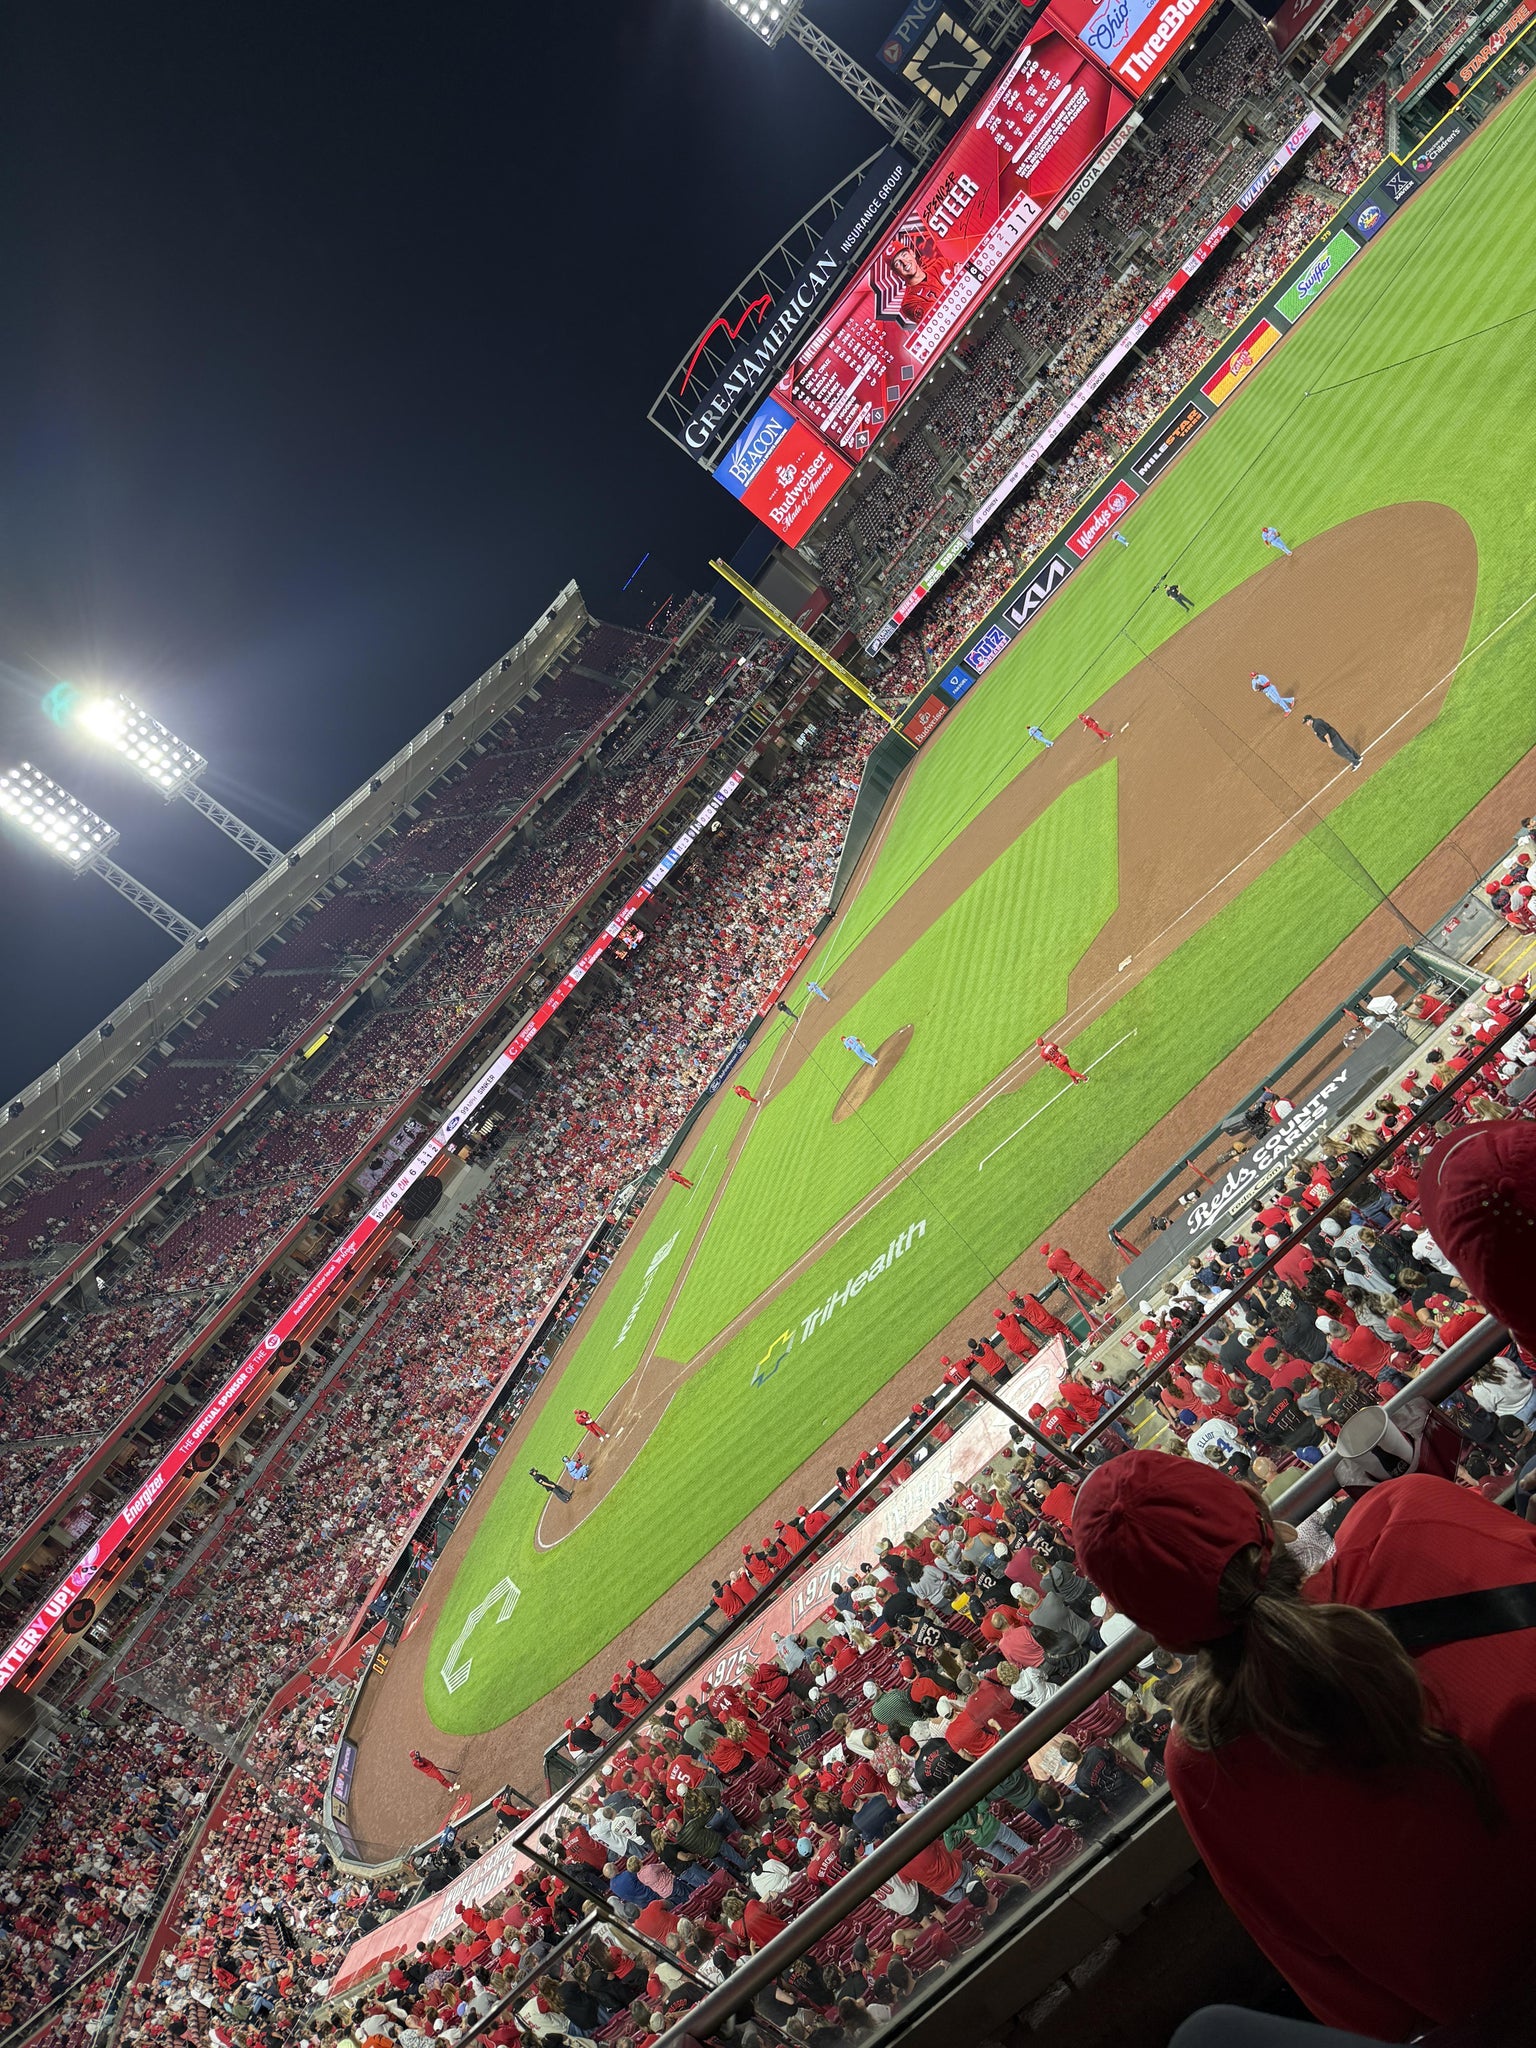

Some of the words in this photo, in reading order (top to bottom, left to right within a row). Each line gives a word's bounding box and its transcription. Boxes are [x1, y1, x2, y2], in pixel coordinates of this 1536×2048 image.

[893, 0, 937, 44] PNC
[1088, 0, 1130, 50] Ohio
[1117, 0, 1201, 85] ThreeBo
[1456, 43, 1494, 82] STAR
[1497, 3, 1532, 39] FIRE
[1423, 73, 1439, 90] SAFETY
[1439, 53, 1457, 72] SERVICE
[1455, 44, 1466, 55] TEXT
[987, 116, 1002, 134] .273
[1003, 89, 1021, 110] .342
[1021, 60, 1041, 82] .449
[1015, 162, 1026, 175] HAS
[1023, 148, 1036, 164] TWO
[1033, 127, 1053, 151] CAREER
[1050, 109, 1066, 129] GAME
[1063, 85, 1085, 112] ENDING
[1031, 134, 1054, 162] INCLUDING
[1051, 121, 1064, 136] ONE
[1062, 90, 1087, 123] WALKOFF
[1283, 122, 1312, 156] ROSE
[1427, 124, 1462, 161] Children's
[1024, 159, 1041, 179] HOMER
[1066, 166, 1101, 207] TOYOTA
[1096, 122, 1135, 168] TUNDRA
[839, 197, 882, 253] INSURANCE
[877, 162, 910, 202] GROUP
[919, 170, 960, 221] SPENCER
[926, 173, 981, 237] STEER
[1393, 179, 1415, 201] XAVIER
[1006, 223, 1019, 235] 3
[1022, 202, 1036, 214] 2
[1203, 225, 1223, 246] MYERS
[1319, 229, 1332, 243] 379
[1298, 255, 1331, 299] Swiffer
[797, 325, 833, 366] CINCINNATI
[817, 357, 831, 374] CRUZ
[1229, 347, 1250, 377] Kahn's
[799, 367, 815, 385] DUNN
[810, 371, 830, 395] BLEDAY
[815, 371, 839, 400] STEWART
[1089, 371, 1107, 390] SINKER
[1178, 412, 1203, 437] TIRES
[727, 414, 785, 484] BEACON
[767, 448, 828, 524] Budweiser
[801, 459, 835, 500] America
[778, 502, 803, 532] Made
[797, 494, 810, 507] of
[1077, 508, 1113, 550] Wendy's
[938, 539, 964, 567] $39,105
[914, 704, 947, 743] Budweiser
[476, 1073, 496, 1095] SINKER
[1187, 1166, 1258, 1238] Reds
[1250, 1064, 1351, 1167] COUNTRY
[1256, 1100, 1329, 1174] CARES
[396, 1176, 410, 1191] CIN
[292, 1291, 314, 1316] Available
[316, 1277, 327, 1289] your
[322, 1263, 336, 1279] local
[801, 1219, 926, 1344] TriHealth
[179, 1437, 195, 1454] THE
[190, 1404, 222, 1440] OFFICIAL
[216, 1371, 248, 1407] SPONSOR
[244, 1362, 256, 1374] OF
[252, 1349, 267, 1364] THE
[1196, 1429, 1215, 1450] ELLIOT
[118, 1471, 170, 1526] Energizer
[0, 1615, 51, 1686] ATTERY
[44, 1584, 76, 1619] UP!
[918, 1624, 944, 1650] 23
[717, 1697, 733, 1712] 44
[676, 1769, 692, 1785] 5
